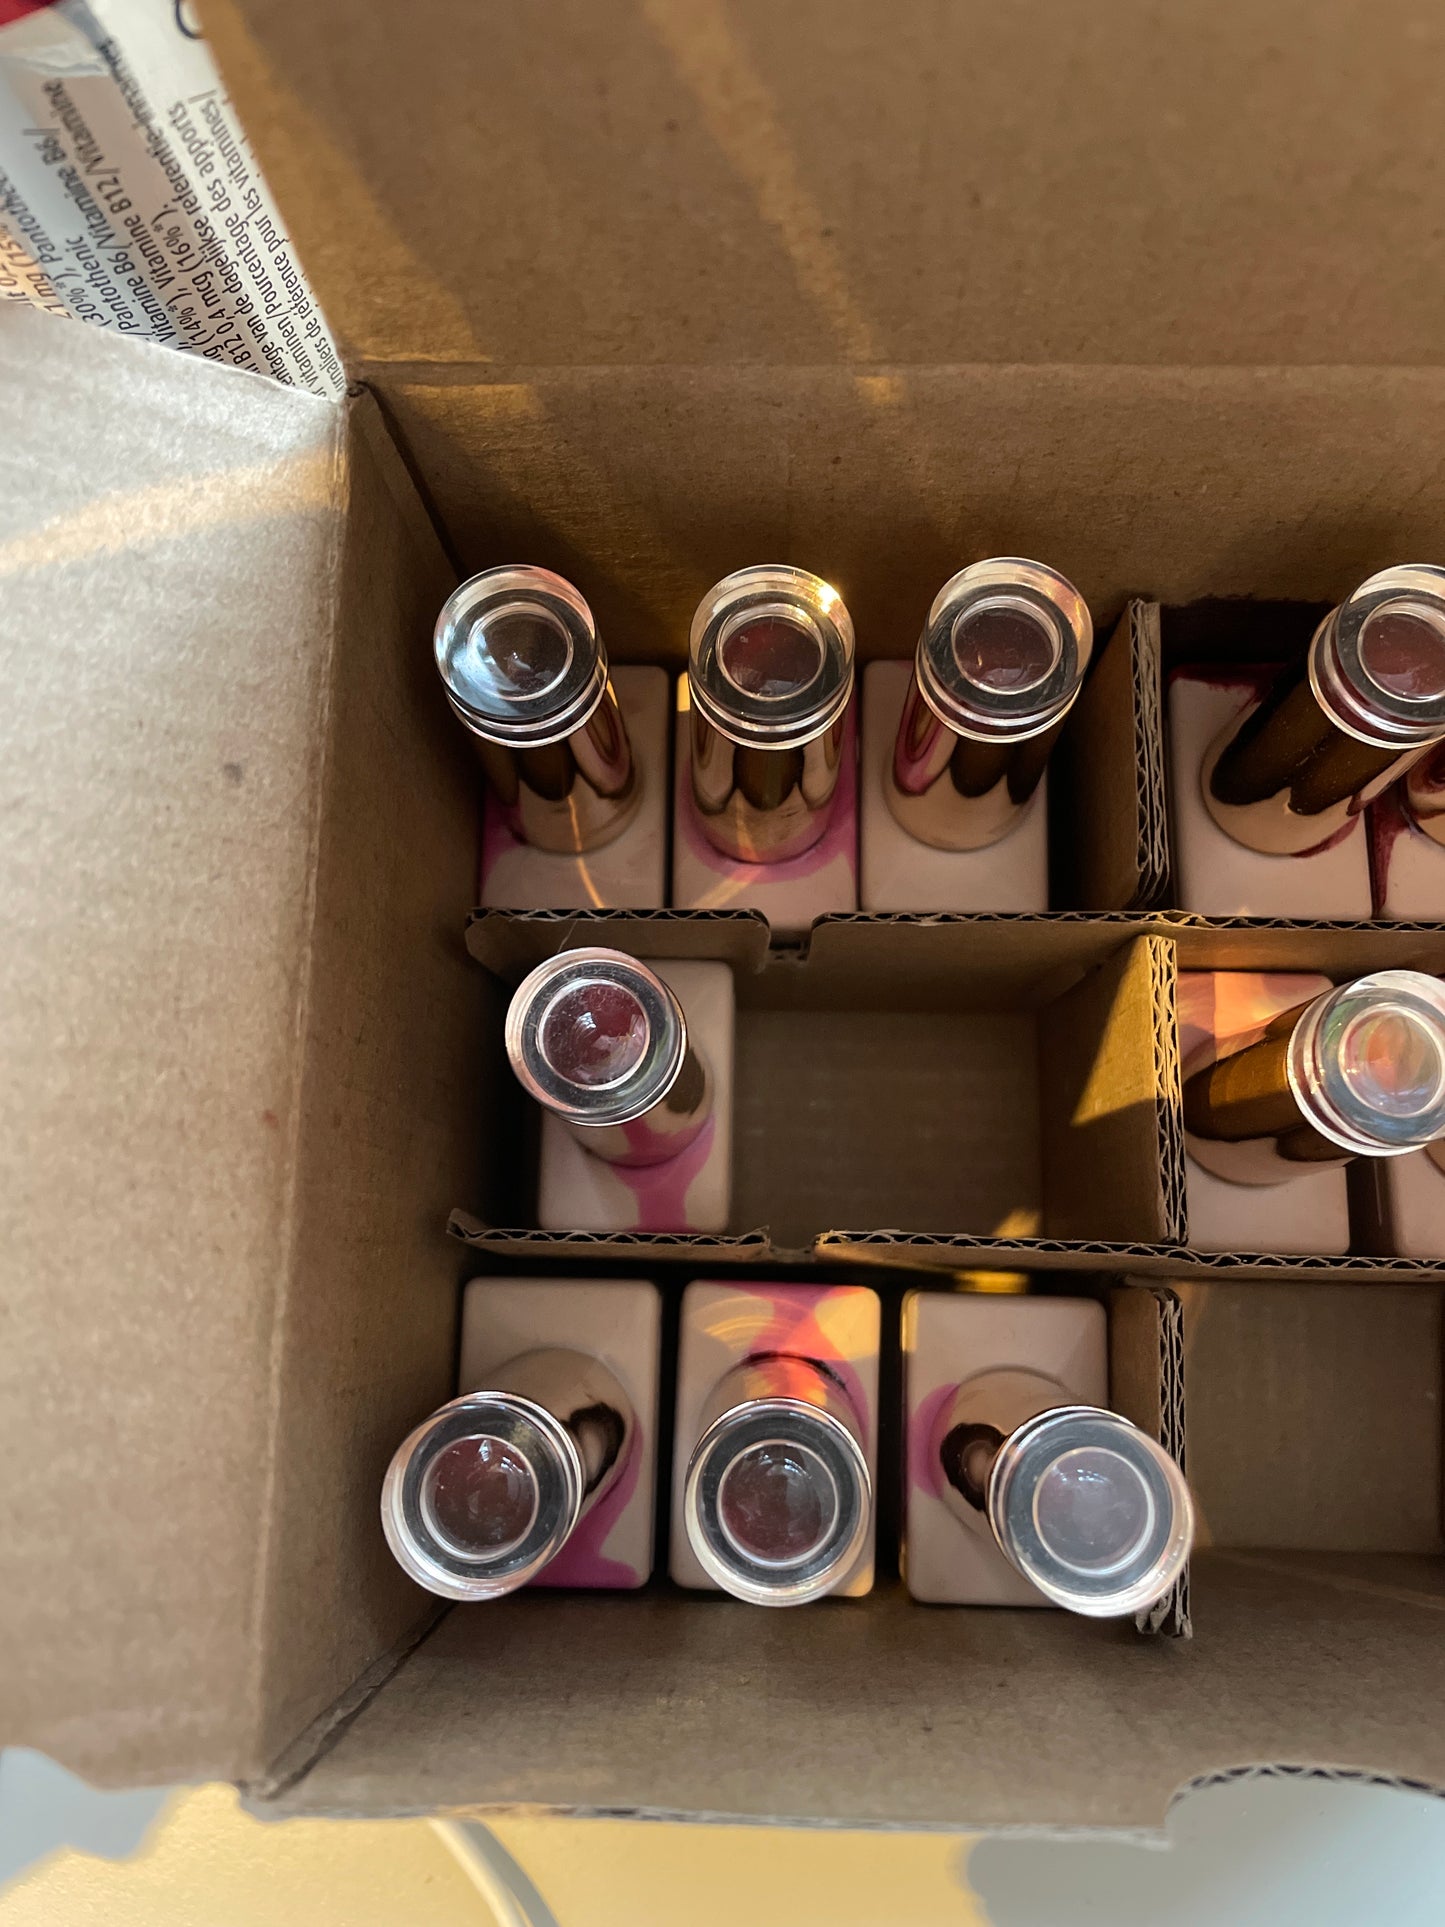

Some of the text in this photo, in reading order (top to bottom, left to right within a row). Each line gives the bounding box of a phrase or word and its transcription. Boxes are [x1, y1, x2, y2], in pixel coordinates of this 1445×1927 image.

[167, 100, 215, 177] apports
[204, 177, 233, 212] des
[240, 187, 263, 220] les
[122, 212, 175, 290] Vitamine
[253, 214, 289, 253] pour
[190, 214, 244, 294] dagelijkse
[24, 272, 58, 296] mg
[188, 269, 221, 308] mcg
[271, 250, 313, 319] référence
[124, 274, 176, 343] Vitamine
[206, 306, 236, 336] 0,4
[233, 292, 256, 315] de
[243, 313, 268, 343] van
[303, 316, 321, 339] de
[221, 331, 252, 364] B12
